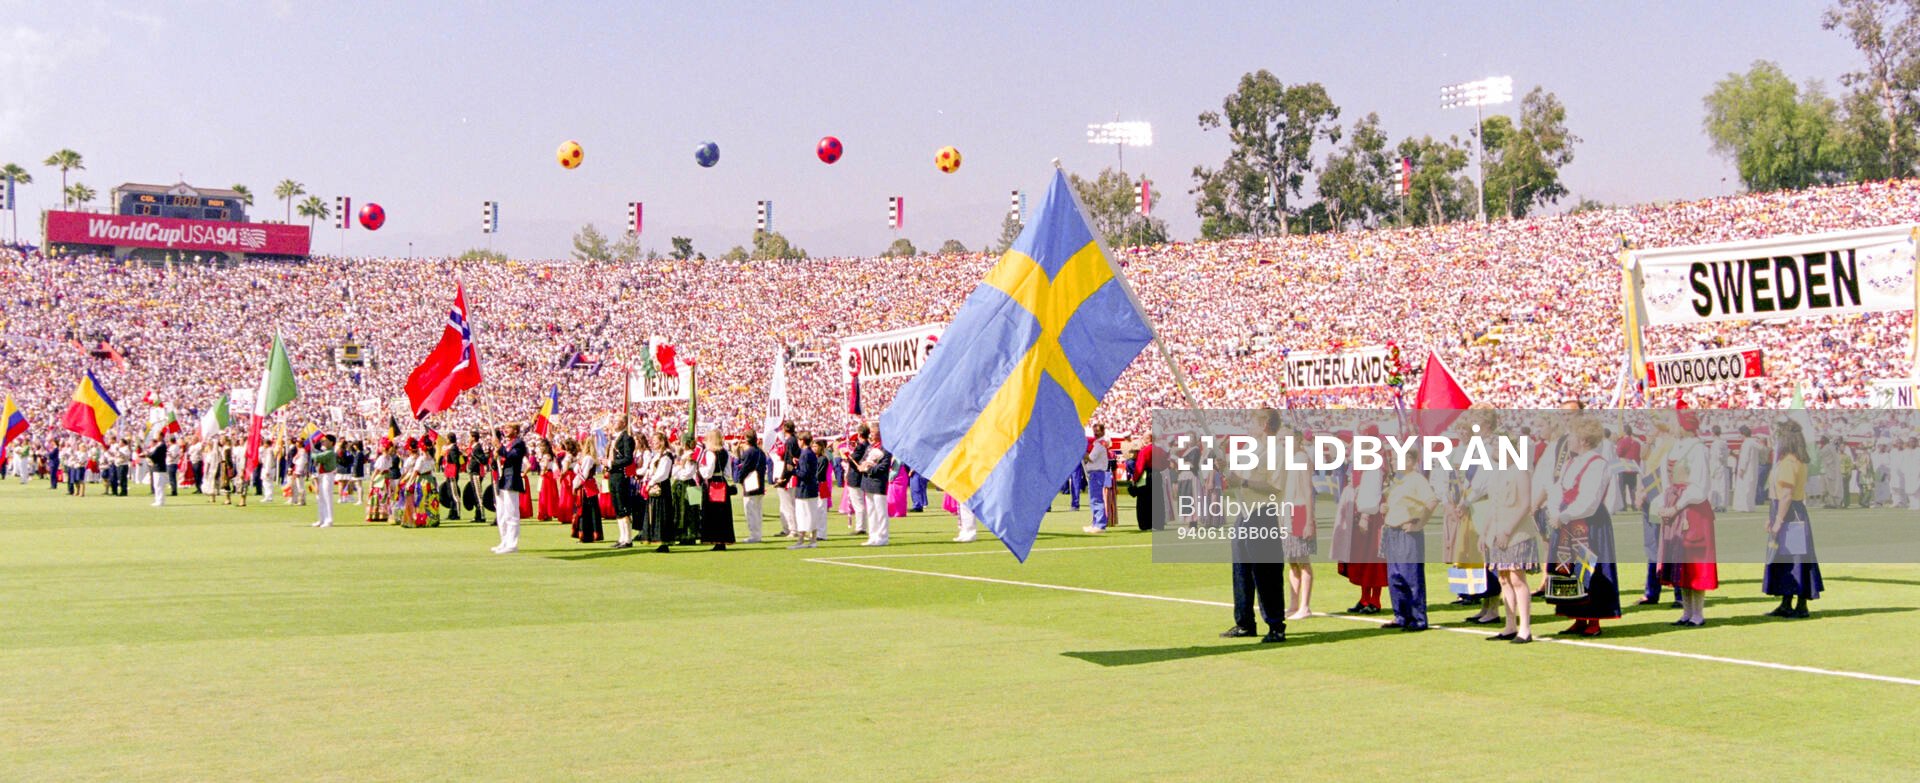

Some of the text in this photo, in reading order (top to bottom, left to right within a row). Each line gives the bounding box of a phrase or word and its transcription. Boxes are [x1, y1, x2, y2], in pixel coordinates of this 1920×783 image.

[1689, 248, 1862, 317] SWEDEN
[862, 337, 919, 376] NORWAY
[1287, 354, 1391, 387] NETHERLANDS
[1657, 353, 1742, 385] MOROCCO
[643, 374, 680, 398] MEXICO
